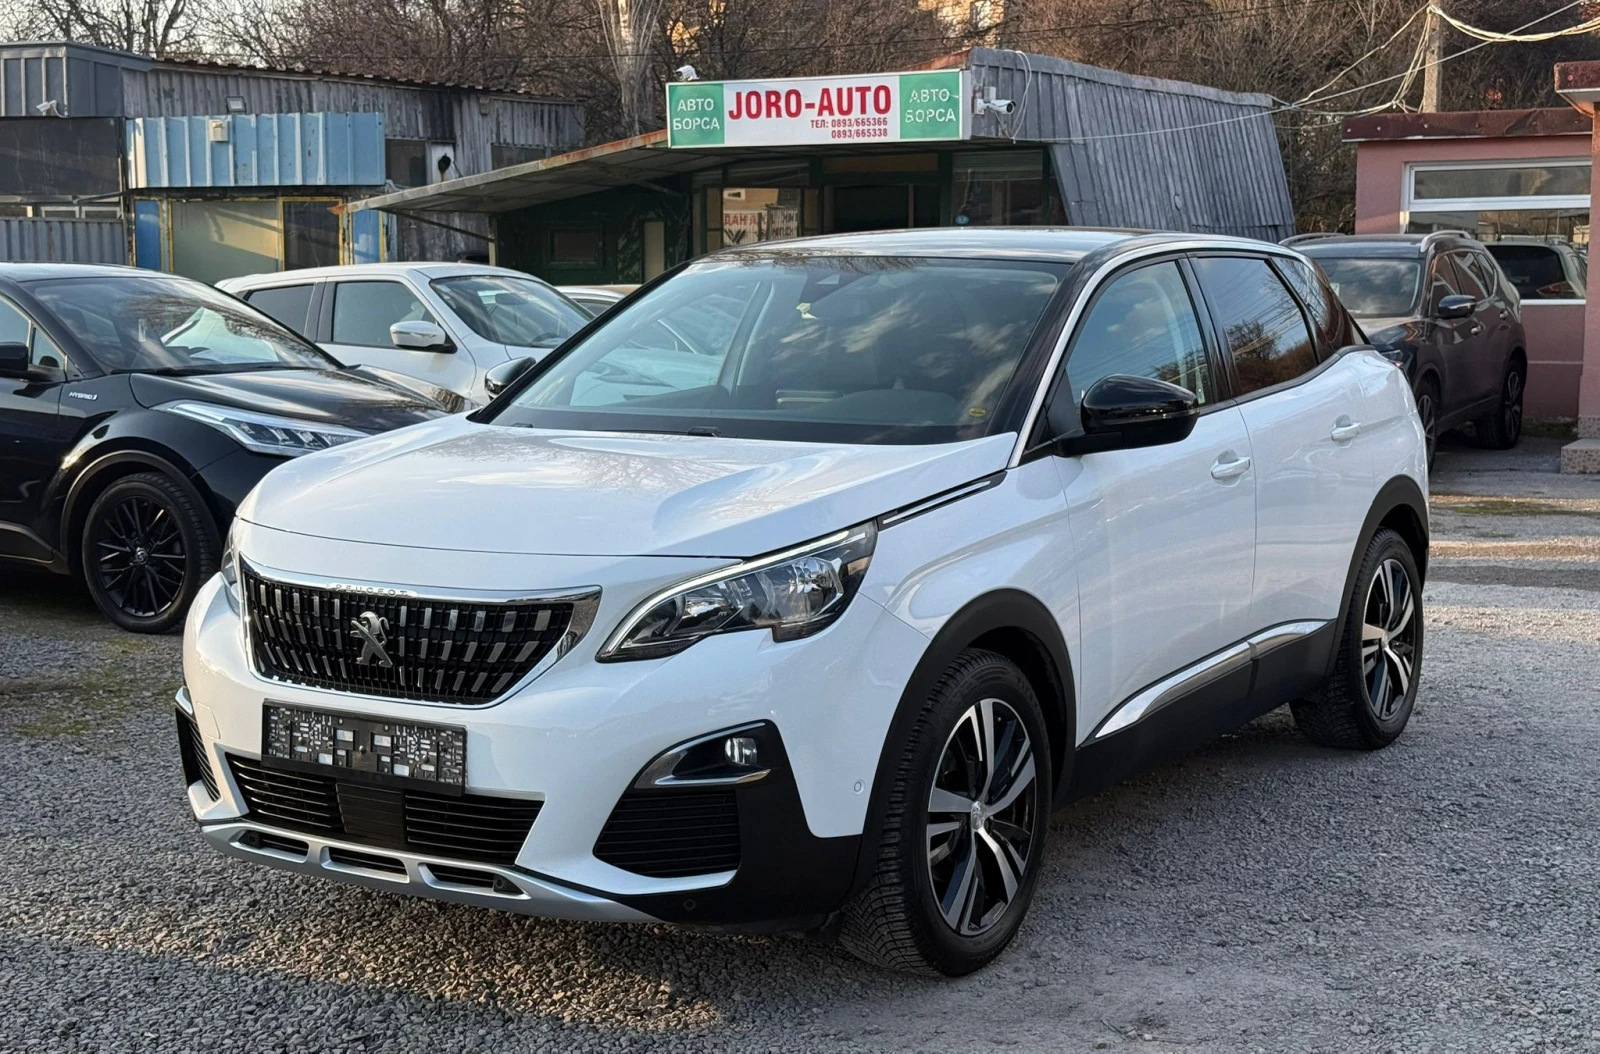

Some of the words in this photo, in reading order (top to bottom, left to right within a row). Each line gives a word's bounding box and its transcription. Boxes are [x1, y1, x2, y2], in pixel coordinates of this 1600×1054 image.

[909, 88, 950, 103] АВТО
[677, 98, 714, 111] АВТО
[728, 85, 892, 120] JORO-AUTO
[905, 108, 956, 123] БОРСА
[673, 117, 720, 130] БОРСА
[810, 120, 829, 128] ТЕЛ:
[831, 117, 888, 128] 0893/665366
[831, 128, 888, 139] 0893/665338
[335, 583, 408, 597] PEUGEOT
